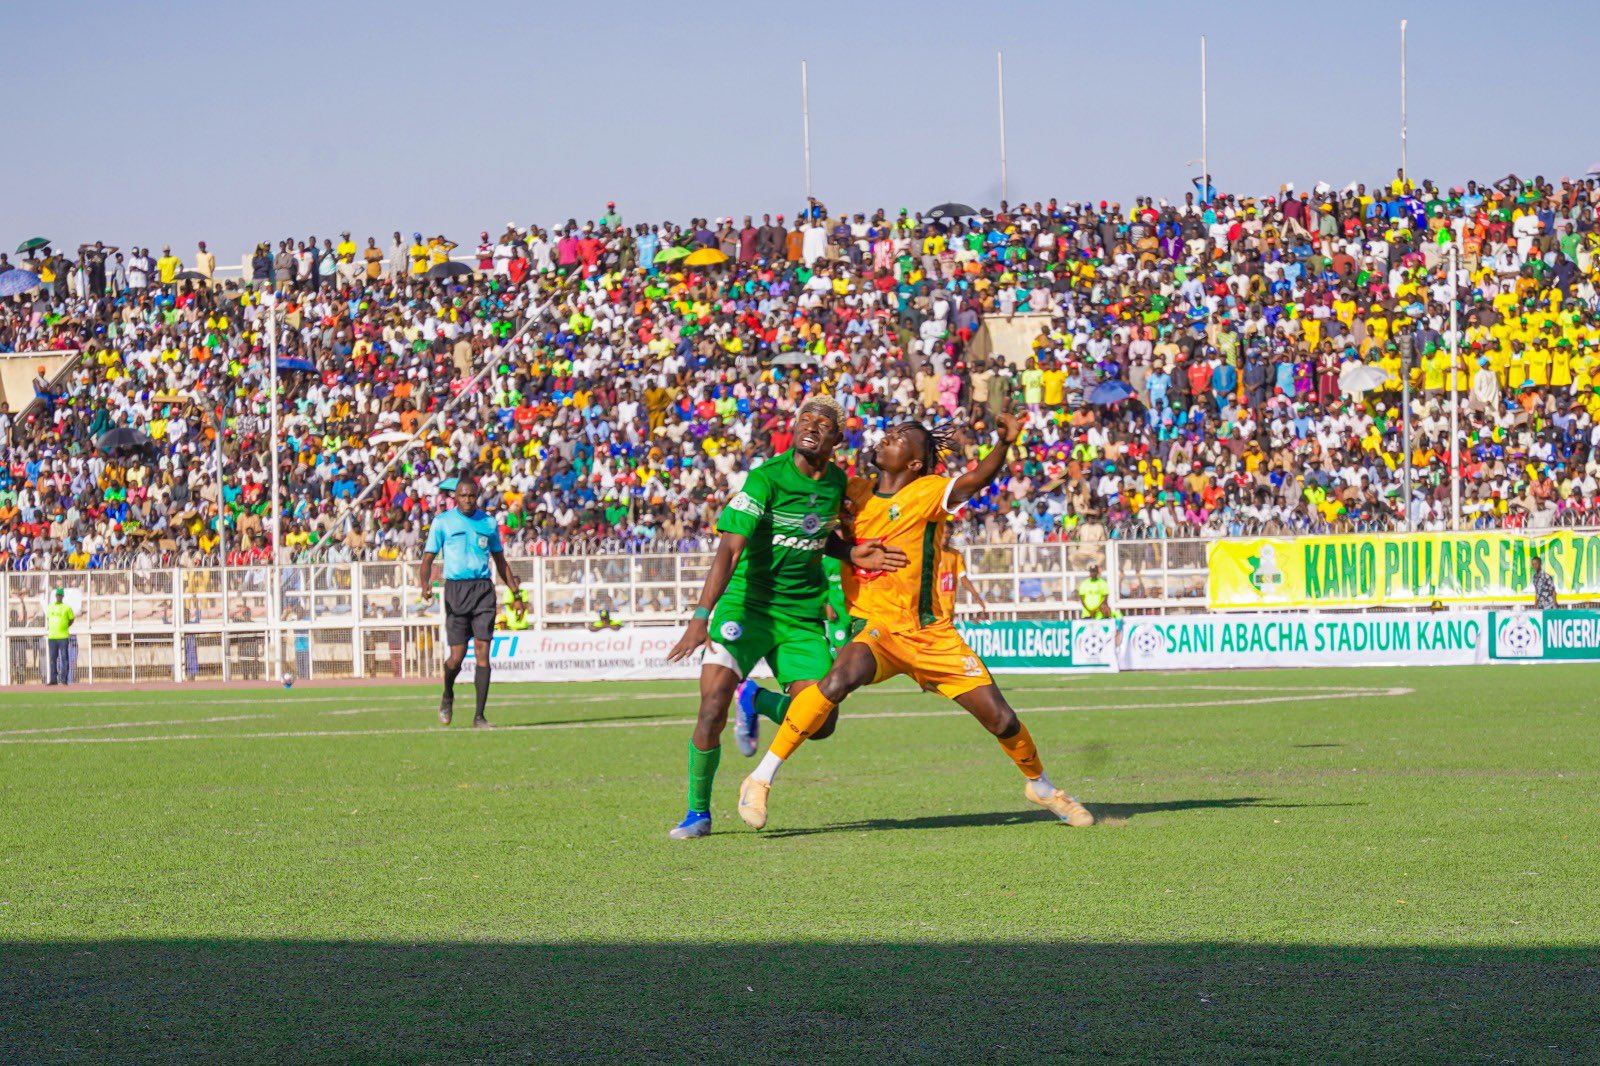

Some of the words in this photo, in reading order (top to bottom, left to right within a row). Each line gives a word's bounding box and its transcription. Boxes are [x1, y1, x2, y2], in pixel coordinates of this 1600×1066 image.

[1304, 541, 1376, 598] KANO
[1385, 539, 1490, 596] PILLARS
[465, 636, 519, 658] TI
[1018, 628, 1071, 657] LEAGUE
[1166, 624, 1214, 653] SANI
[1221, 623, 1308, 652] ABACHA
[1314, 621, 1411, 651] STADIUM
[1417, 619, 1480, 651] KANO
[598, 658, 635, 668] BANKING
